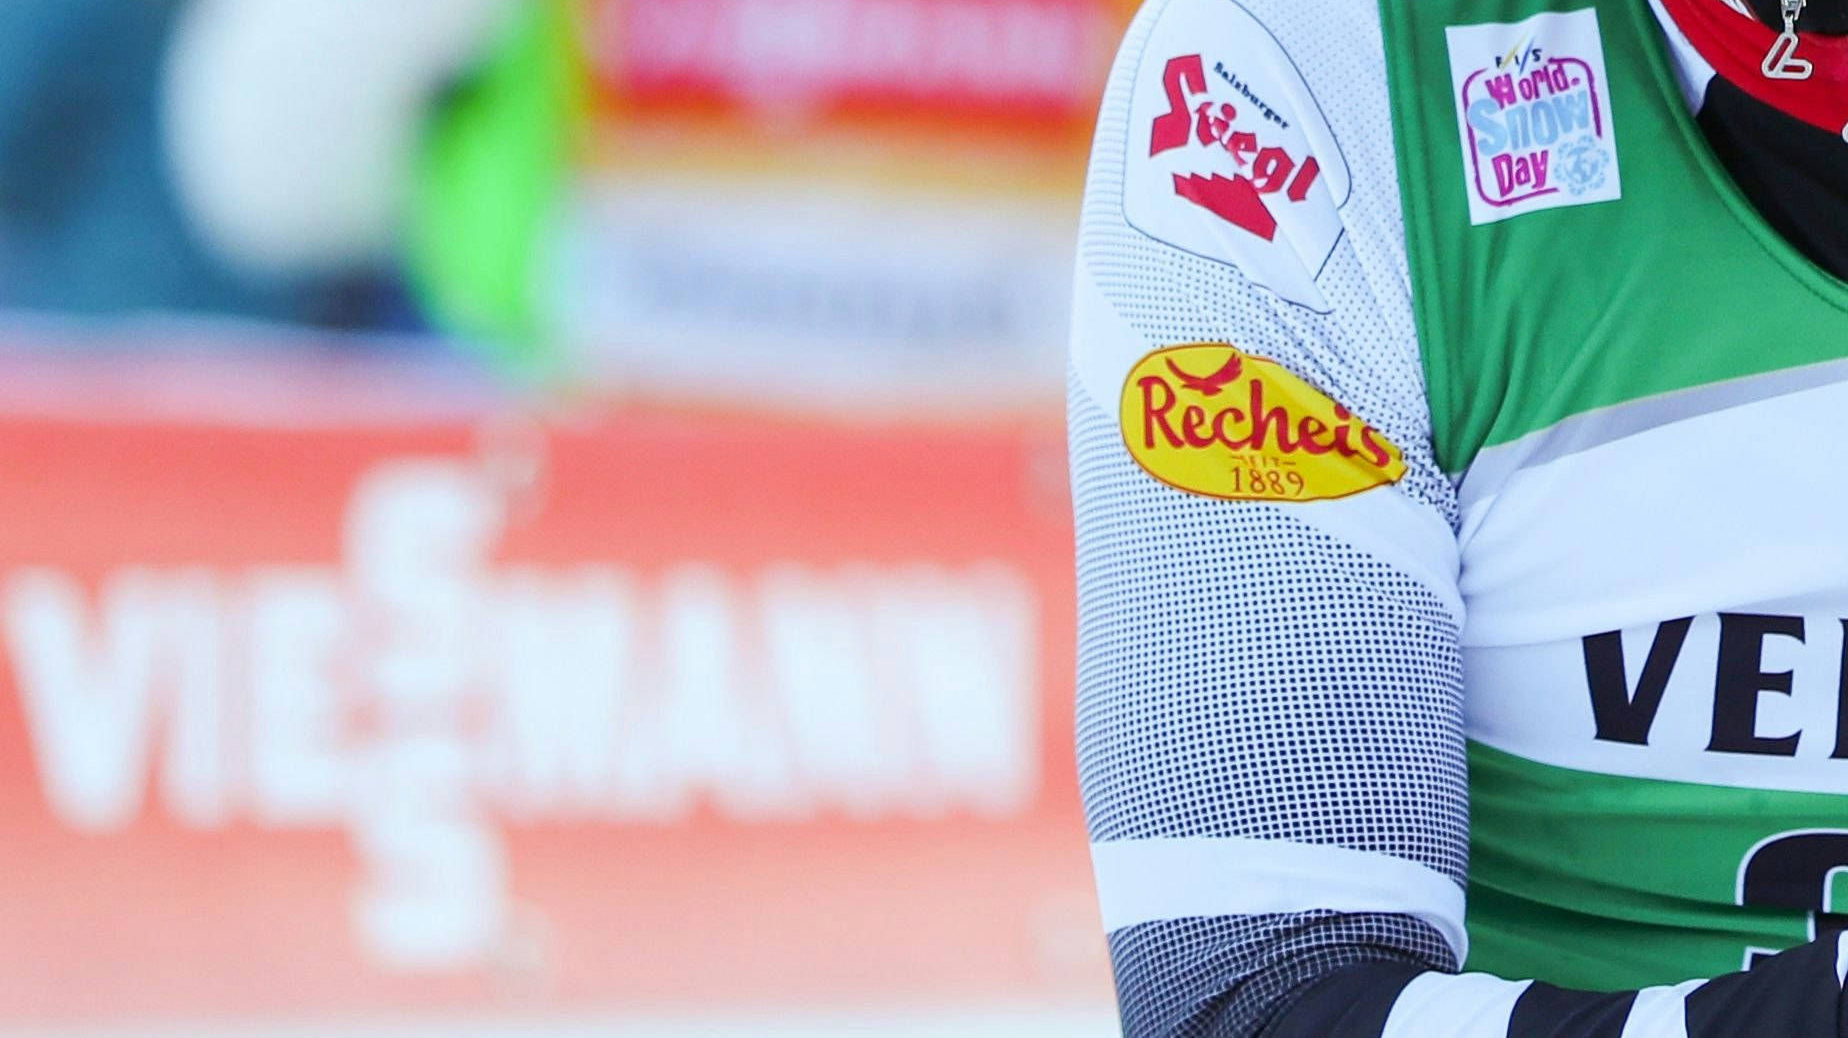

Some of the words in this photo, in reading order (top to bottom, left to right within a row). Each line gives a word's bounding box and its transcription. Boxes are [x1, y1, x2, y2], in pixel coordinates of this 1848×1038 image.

[1149, 53, 1321, 203] Stiegl
[1213, 61, 1290, 130] Salzburger
[1467, 88, 1590, 157] Snow
[1491, 149, 1549, 198] Day
[1137, 375, 1390, 468] Recheis
[1231, 466, 1305, 497] 1889
